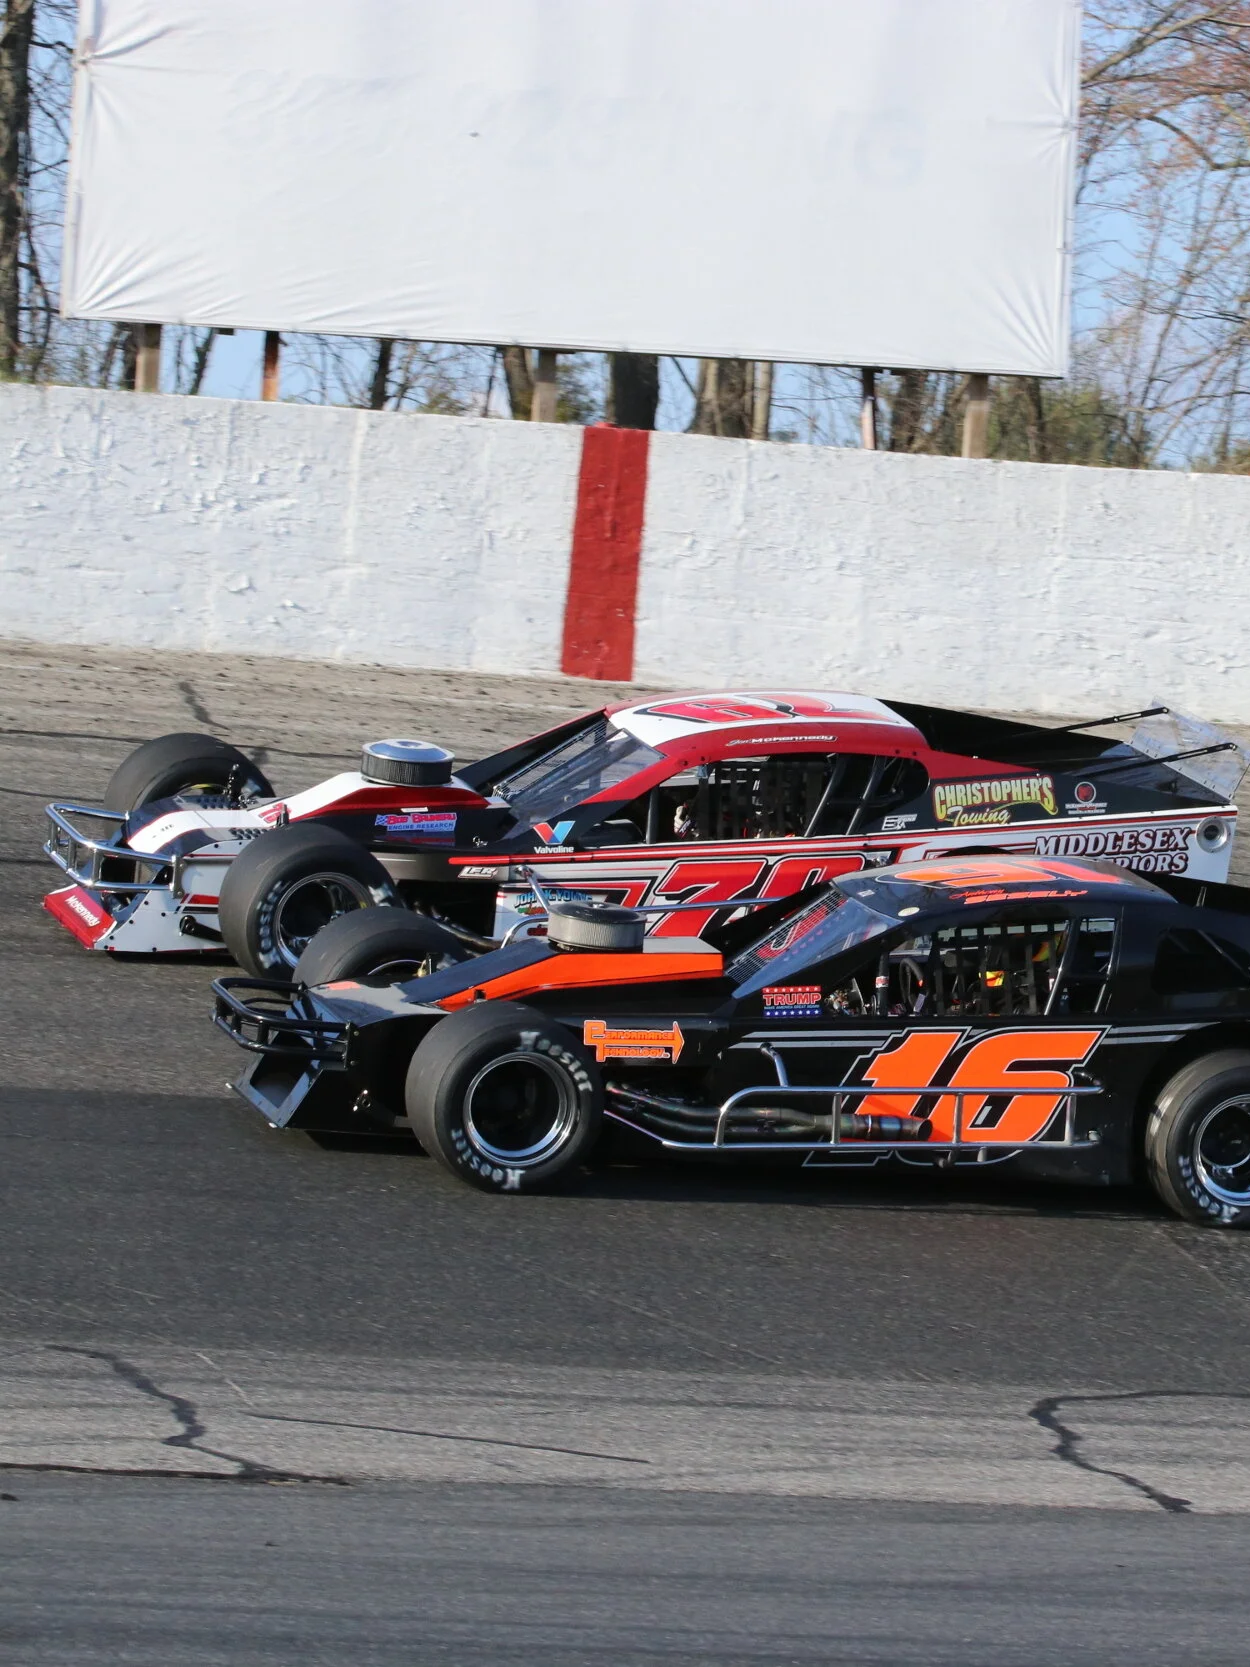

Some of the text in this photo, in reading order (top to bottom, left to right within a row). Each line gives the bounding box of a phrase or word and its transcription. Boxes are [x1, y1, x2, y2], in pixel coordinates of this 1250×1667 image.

[934, 776, 1056, 820] CHRISTOPHER'S
[947, 806, 1011, 827] Towing
[533, 845, 575, 854] Valvoline
[1034, 827, 1192, 856] MIDDLESEX
[763, 992, 822, 1006] TRUMP
